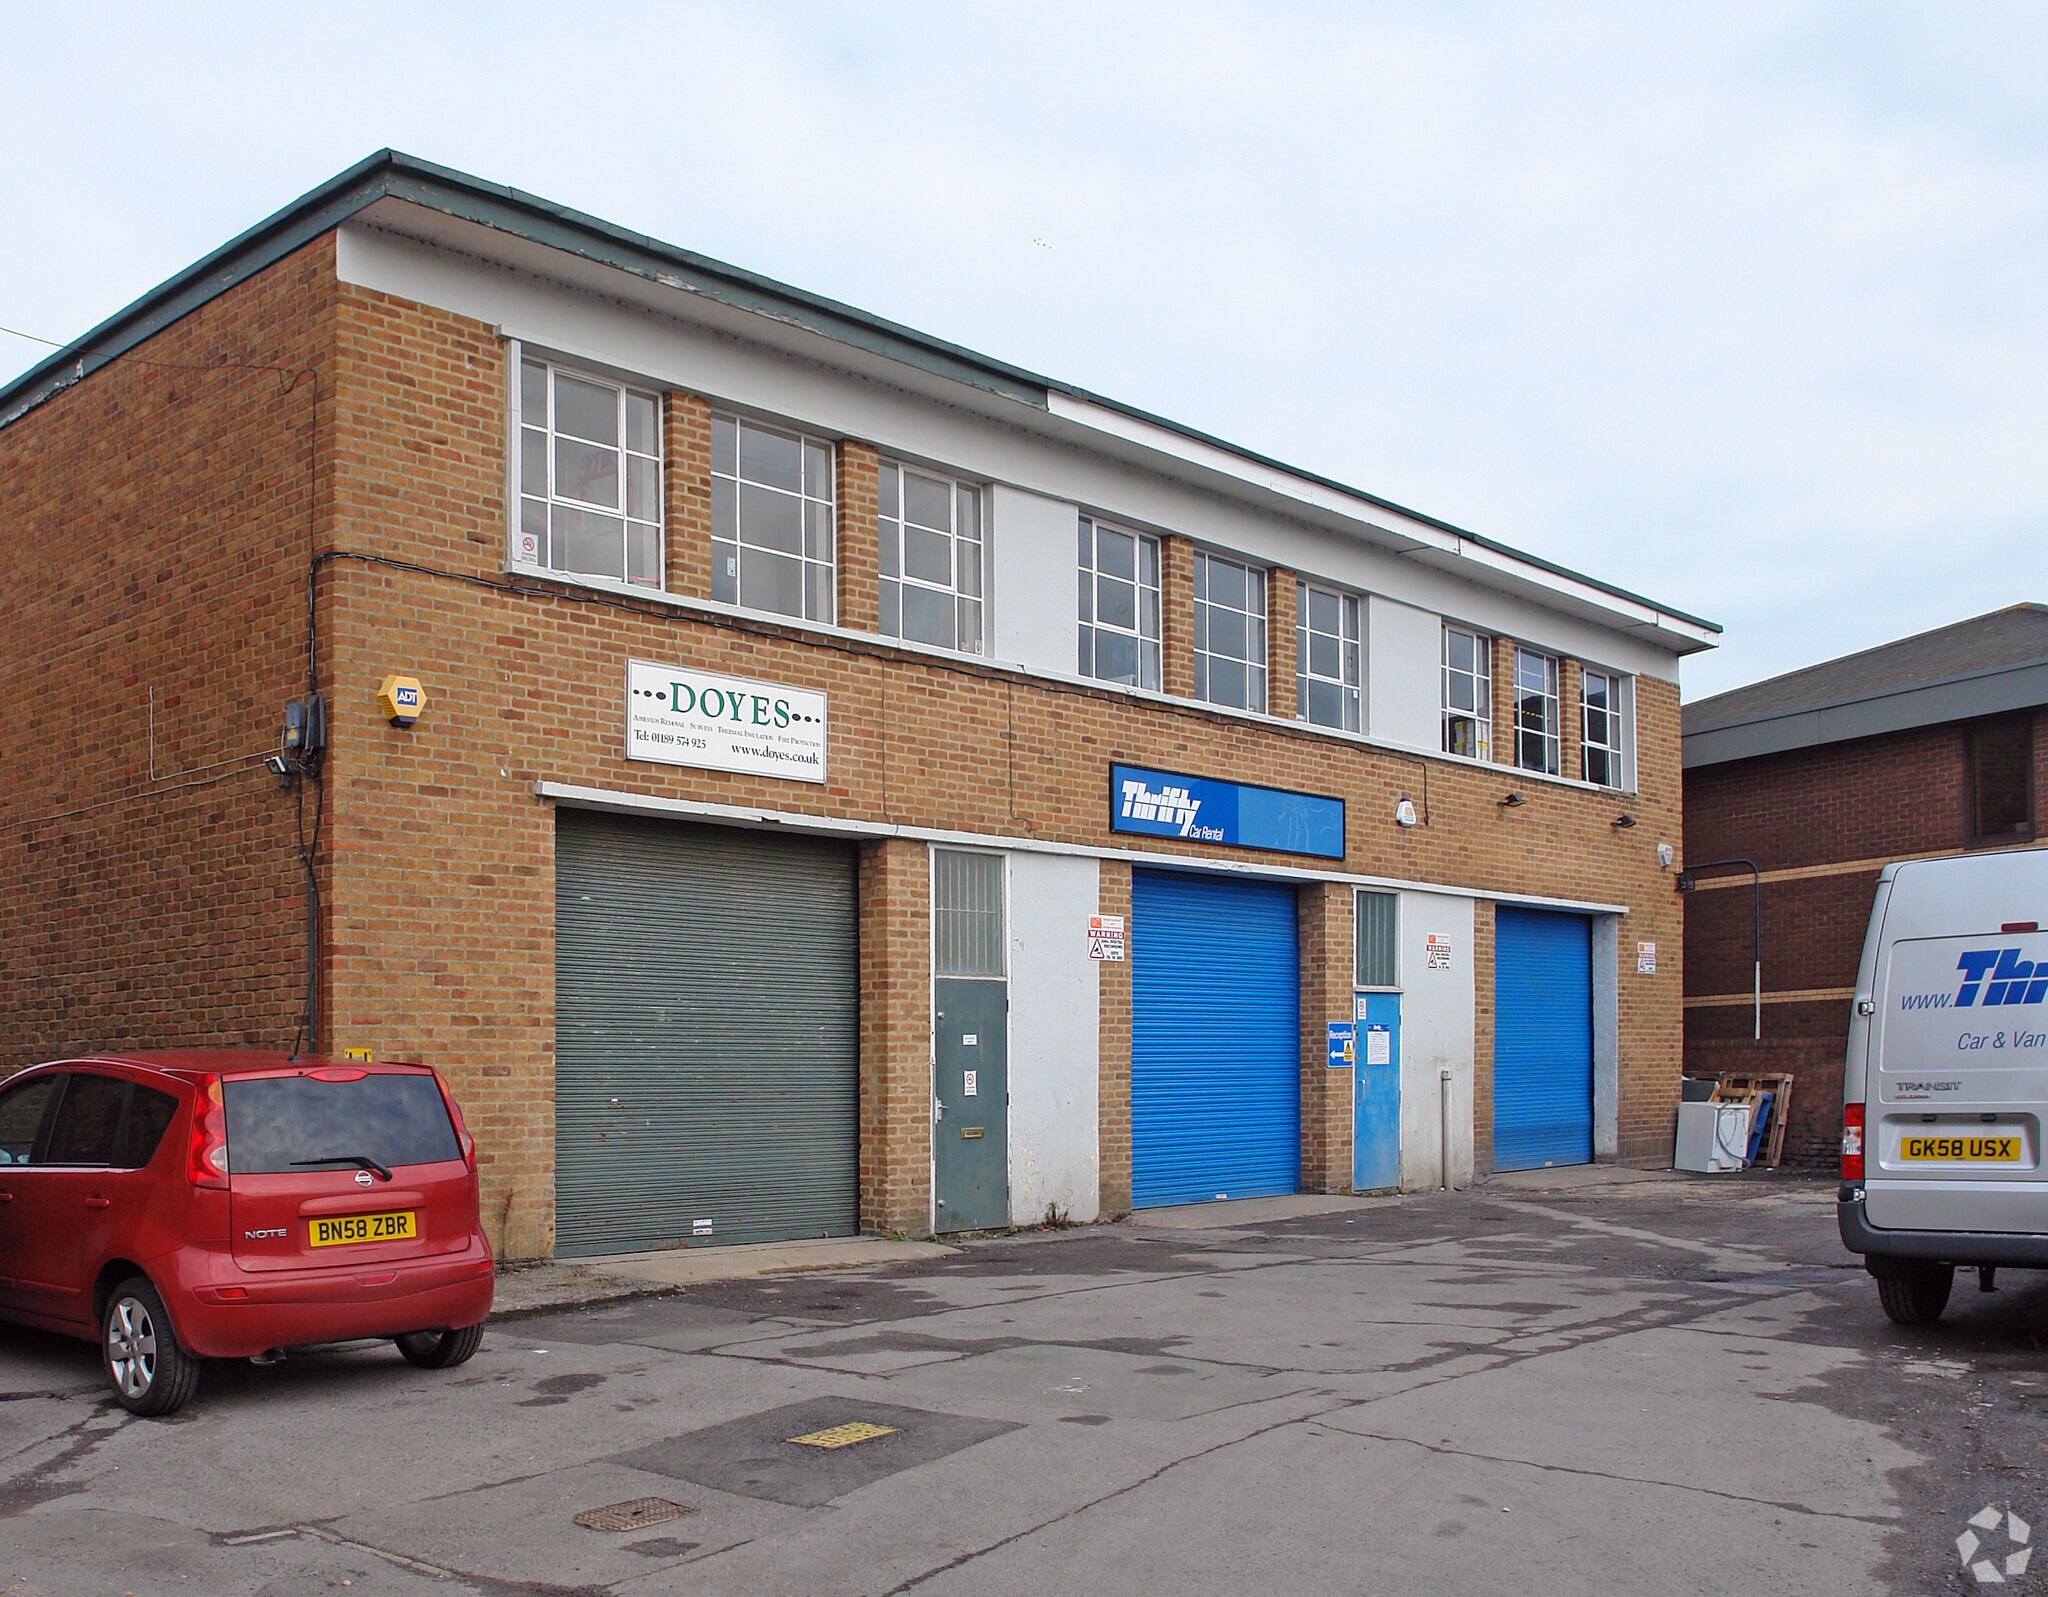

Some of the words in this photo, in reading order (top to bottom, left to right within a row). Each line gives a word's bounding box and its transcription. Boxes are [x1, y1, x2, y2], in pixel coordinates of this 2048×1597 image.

[397, 689, 417, 703] ADT
[669, 682, 790, 729] DOYES
[634, 729, 650, 741] Tel:
[651, 732, 674, 745] 01189
[676, 735, 690, 747] 574
[691, 737, 707, 749] 925
[731, 745, 820, 765] www.doyes.co.uk
[1121, 780, 1202, 837] Thrifty
[1189, 824, 1203, 838] Car
[1201, 826, 1225, 841] Rental
[1089, 930, 1124, 939] WARNING
[1957, 1032, 1990, 1051] Car
[1992, 1031, 2007, 1049] &
[2013, 1030, 2047, 1048] Van
[1896, 1082, 1962, 1092] TRANSIT
[1910, 1139, 1964, 1157] GK58
[1969, 1139, 2012, 1157] USX
[244, 1228, 288, 1240] NOTE
[318, 1219, 368, 1242] BN58
[372, 1215, 408, 1236] ZBR
